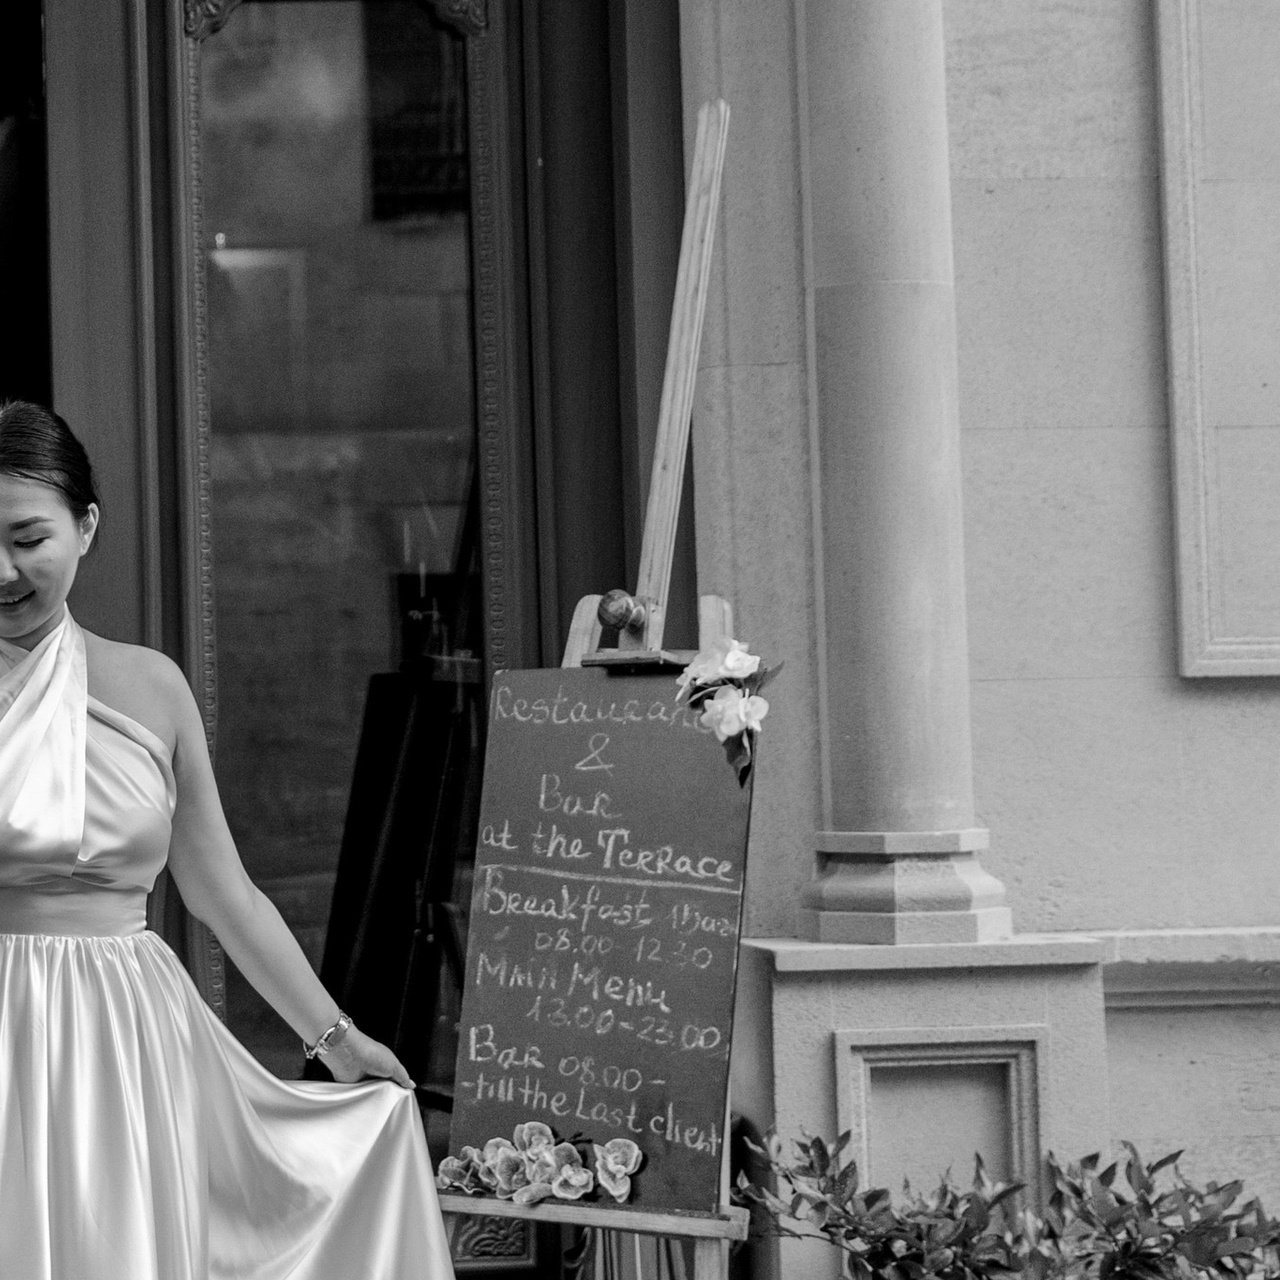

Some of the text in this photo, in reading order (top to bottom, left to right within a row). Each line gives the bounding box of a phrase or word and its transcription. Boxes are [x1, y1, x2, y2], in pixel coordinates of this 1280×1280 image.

[482, 819, 519, 850] at
[531, 822, 593, 859] the
[518, 1075, 570, 1117] the
